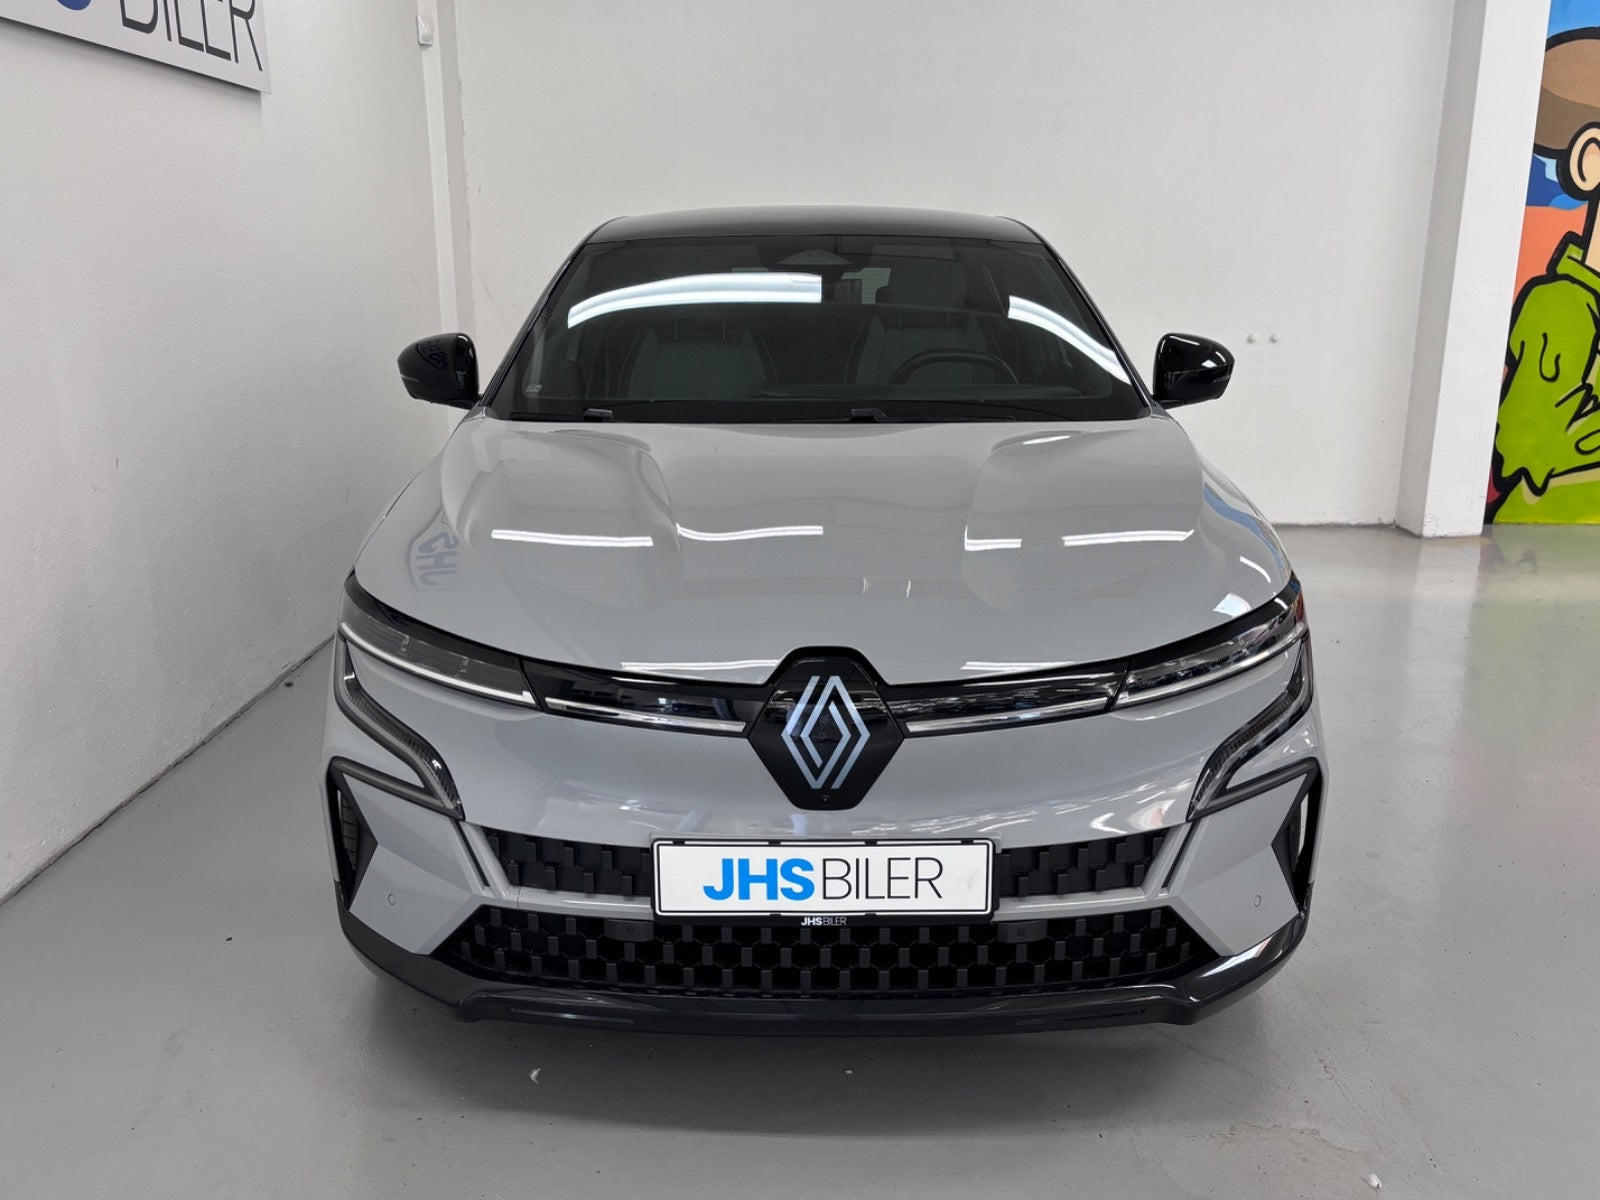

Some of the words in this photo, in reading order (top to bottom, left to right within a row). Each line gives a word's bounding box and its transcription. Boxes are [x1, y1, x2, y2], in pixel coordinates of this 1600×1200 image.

[703, 858, 815, 901] JHS
[822, 857, 943, 900] BILER
[801, 916, 822, 926] JHS
